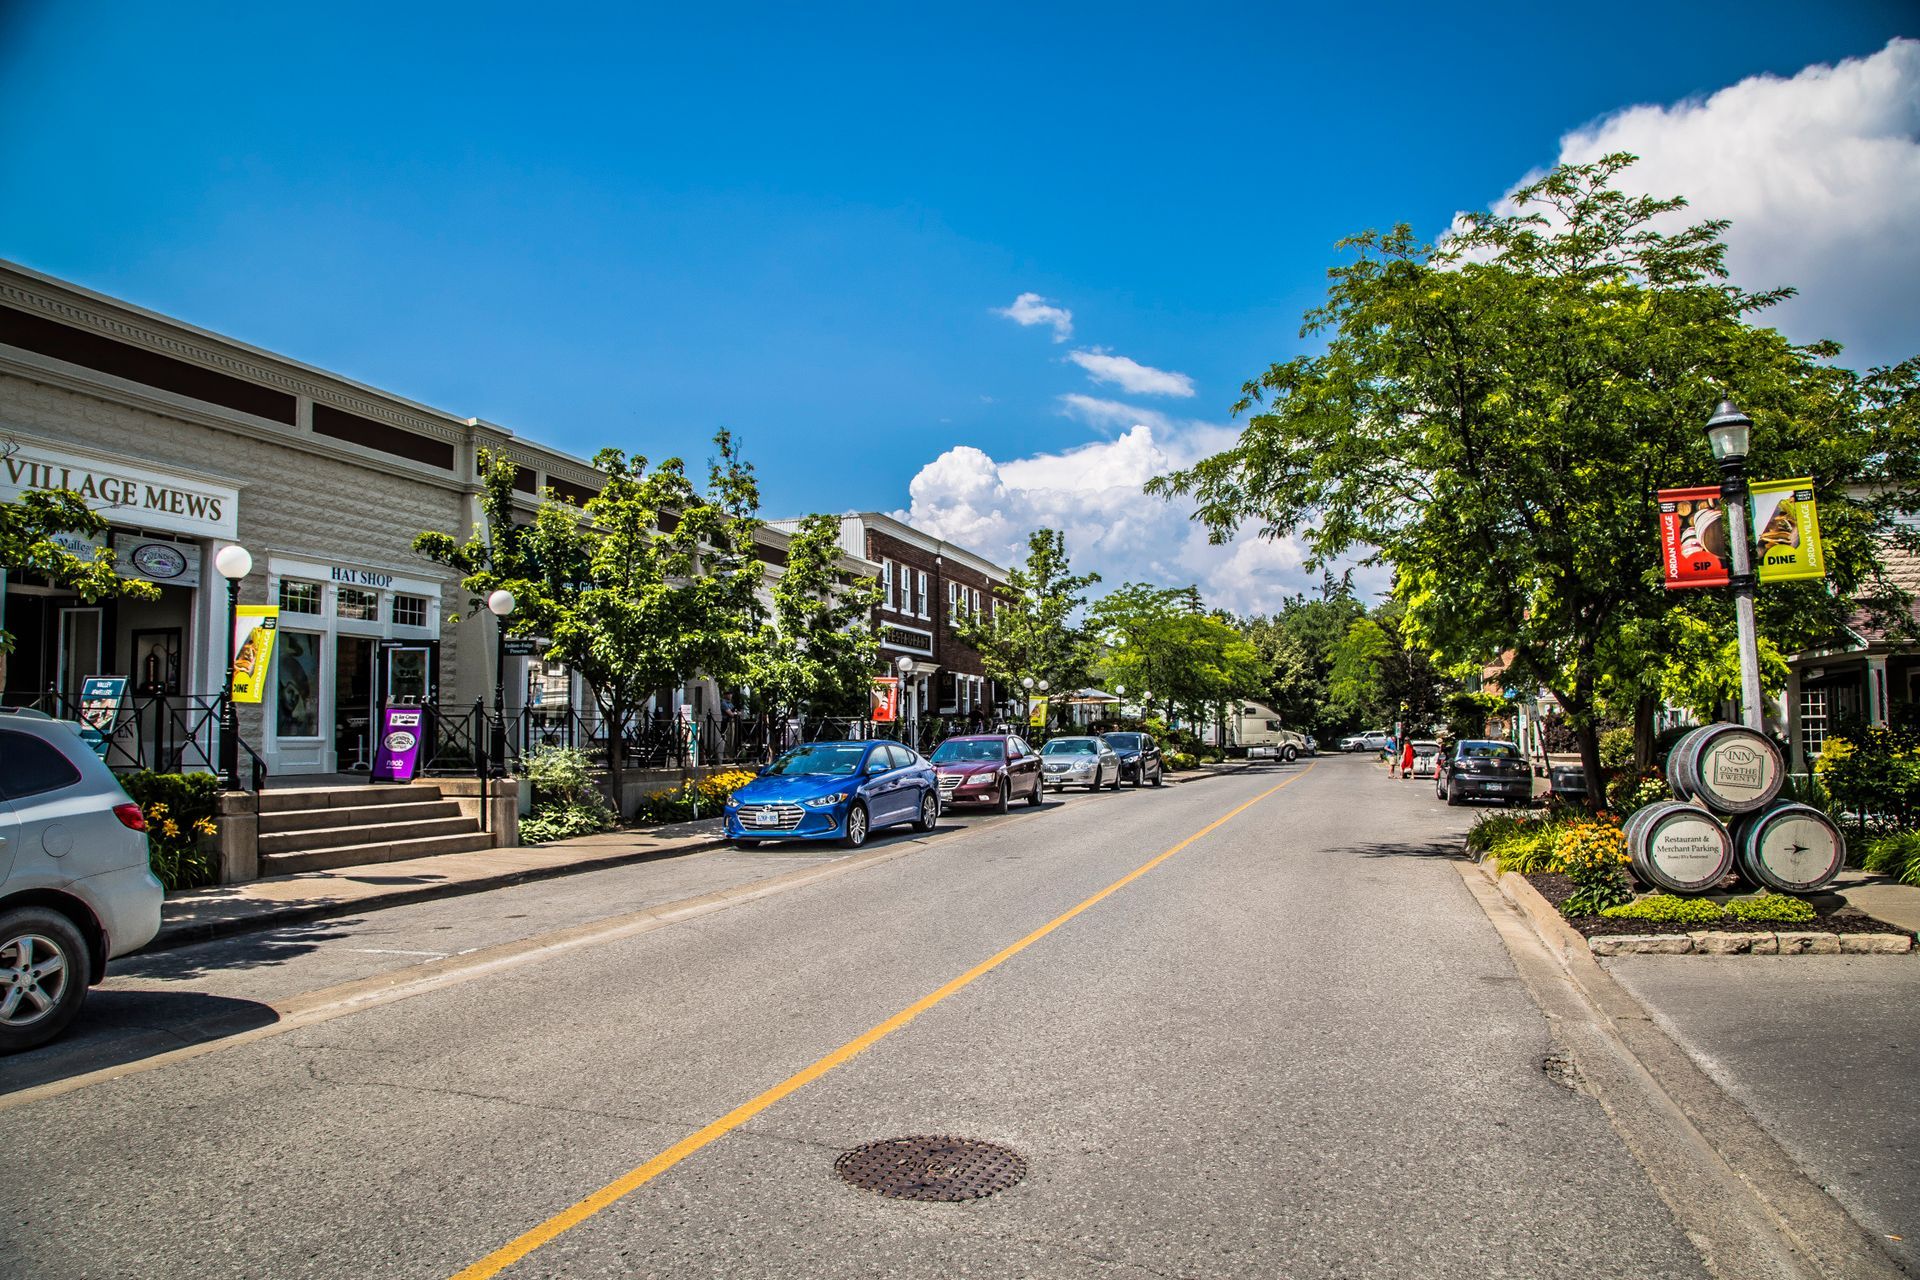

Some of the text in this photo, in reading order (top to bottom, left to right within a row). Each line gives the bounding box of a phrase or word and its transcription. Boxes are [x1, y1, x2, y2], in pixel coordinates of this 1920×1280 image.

[6, 458, 222, 521] VILLAGE MEWS
[1801, 504, 1812, 535] VILLAGE
[1665, 515, 1675, 546] VILLAGE
[1807, 537, 1817, 567] JORDAN
[1668, 548, 1678, 579] JORDAN
[1693, 562, 1711, 571] SIP
[1767, 555, 1797, 565] DINE
[331, 567, 393, 587] HAT SHOP
[260, 630, 272, 662] VILLAGE
[1728, 751, 1751, 761] INN
[1720, 773, 1757, 783] TWENTY
[1740, 767, 1757, 775] THE
[1664, 835, 1702, 843] Restaurant
[1657, 845, 1719, 854] Merchant Parking
